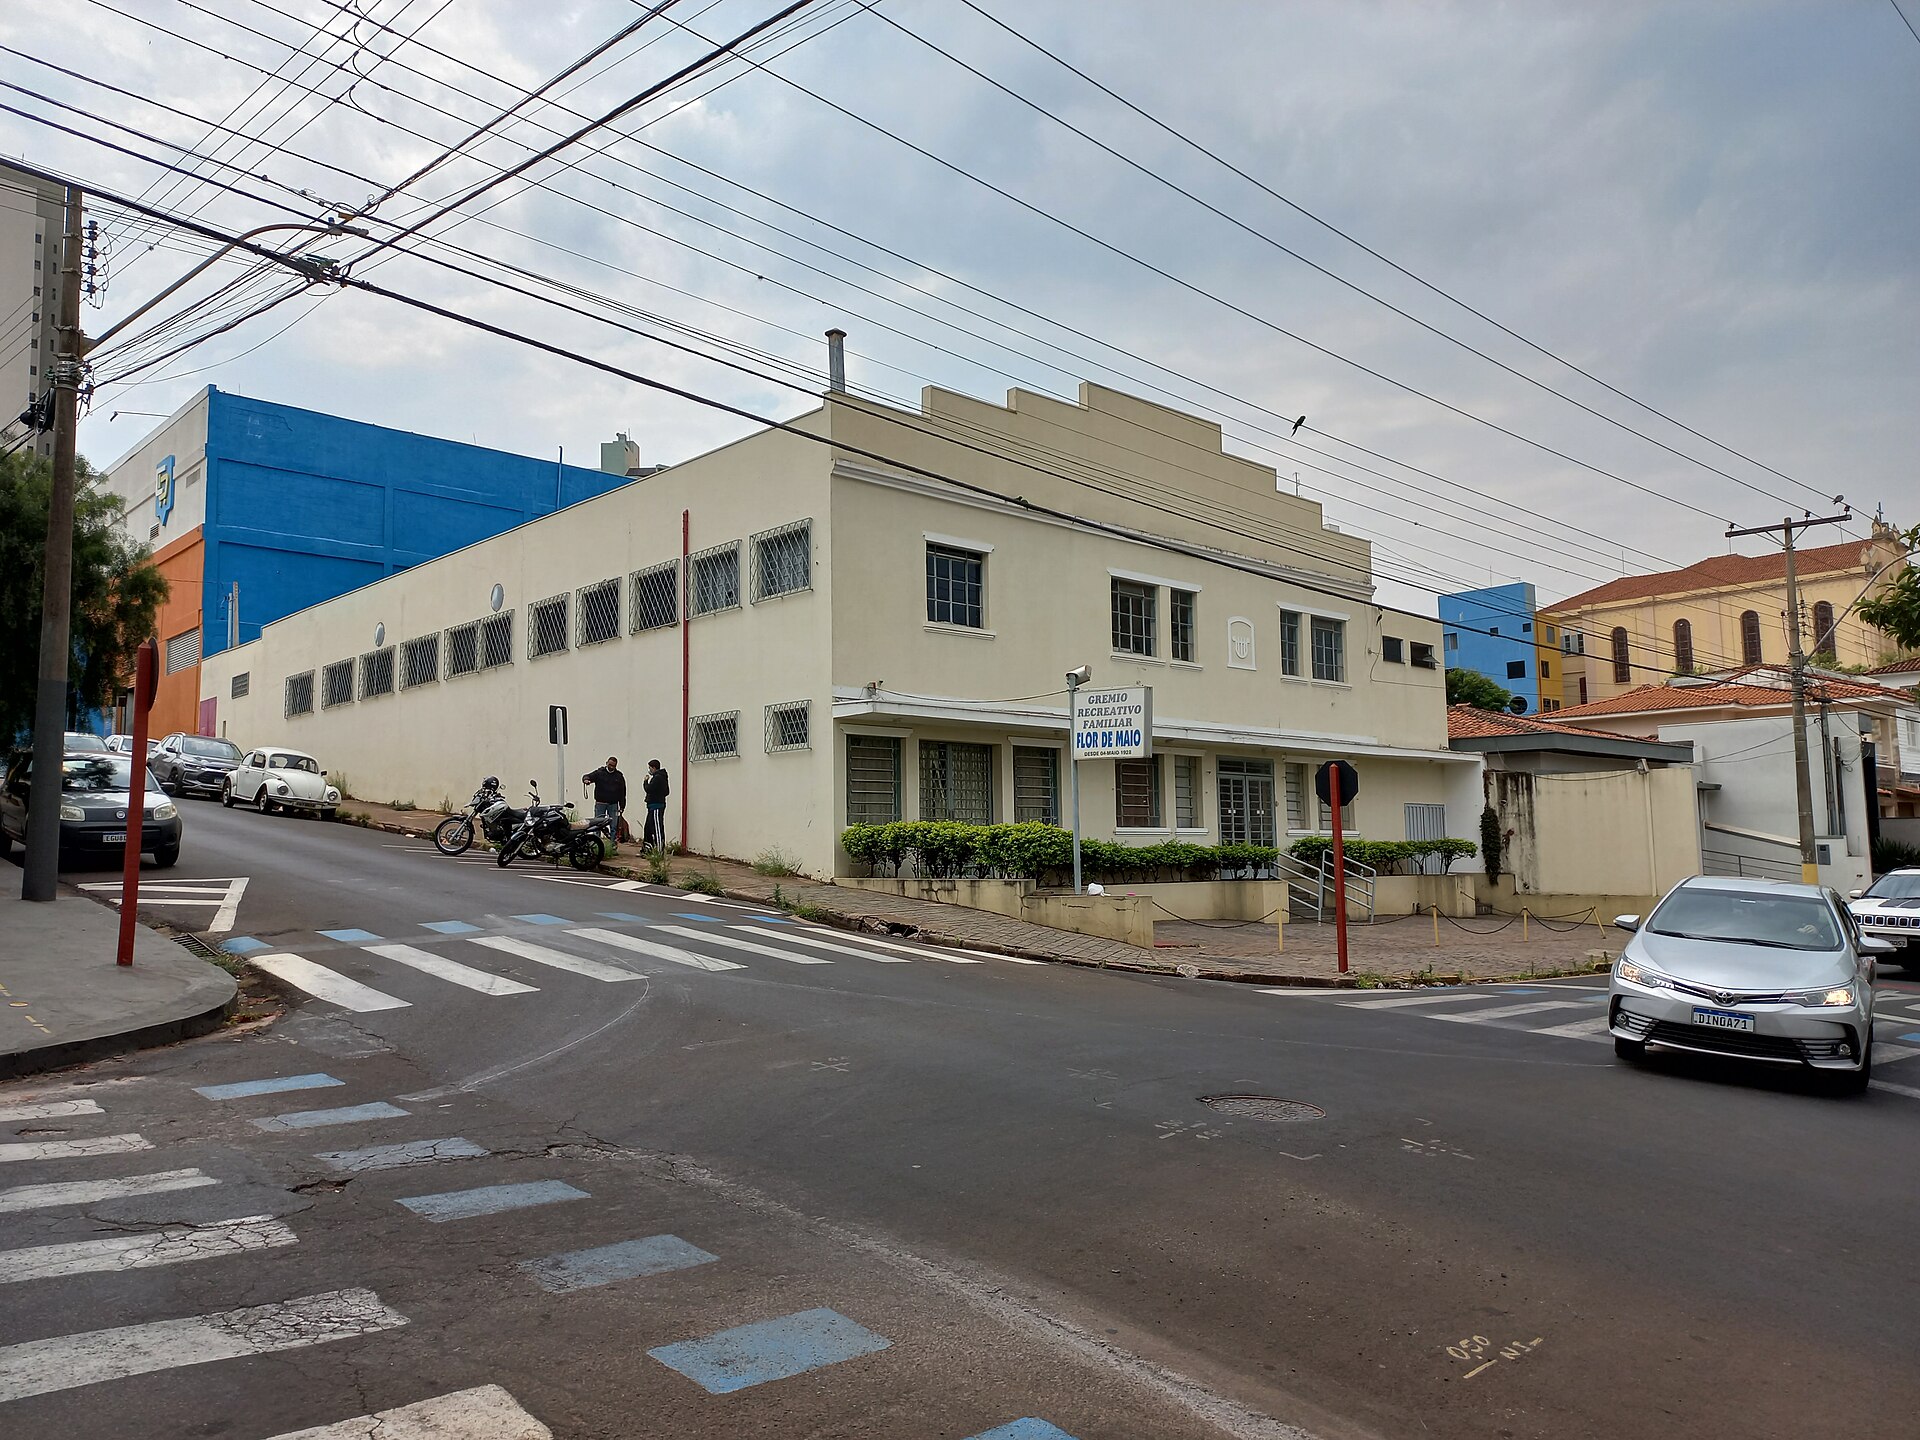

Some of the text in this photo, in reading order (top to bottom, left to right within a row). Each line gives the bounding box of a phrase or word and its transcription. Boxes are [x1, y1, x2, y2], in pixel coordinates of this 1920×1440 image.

[1088, 693, 1128, 704] GREMIO
[1077, 705, 1142, 717] RECREATIVO
[1082, 717, 1133, 729] FAMILIAR
[1076, 729, 1141, 749] FLOR DE MAIO
